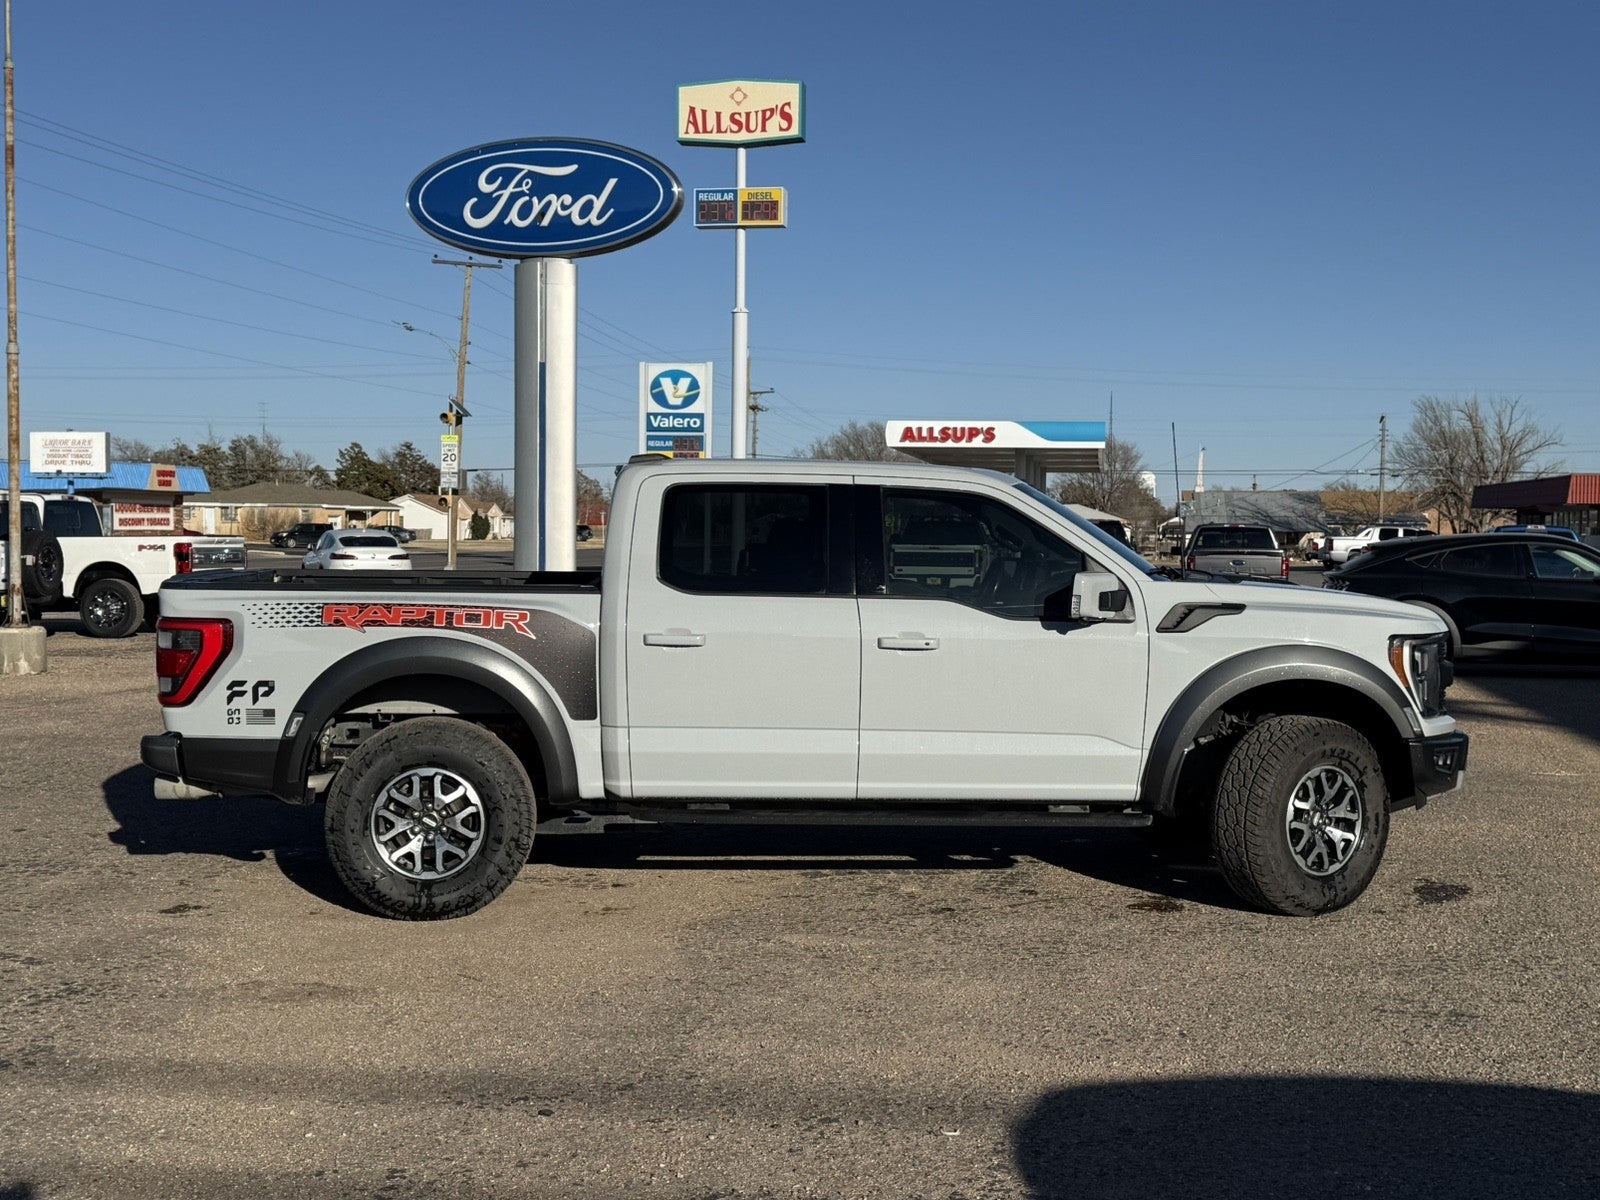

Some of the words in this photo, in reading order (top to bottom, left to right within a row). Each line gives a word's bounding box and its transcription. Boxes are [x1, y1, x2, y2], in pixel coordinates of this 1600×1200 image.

[684, 102, 793, 134] ALLSUP'S
[463, 163, 618, 228] Ford
[699, 192, 734, 201] REGULAR
[747, 191, 774, 200] DIESEL
[650, 415, 701, 428] Valero
[900, 426, 996, 443] ALLSUP'S
[442, 453, 457, 462] 20
[119, 518, 145, 527] DISCOUNT
[146, 518, 170, 527] TOBACCO
[322, 604, 536, 640] RAPTOR
[226, 680, 276, 706] FP
